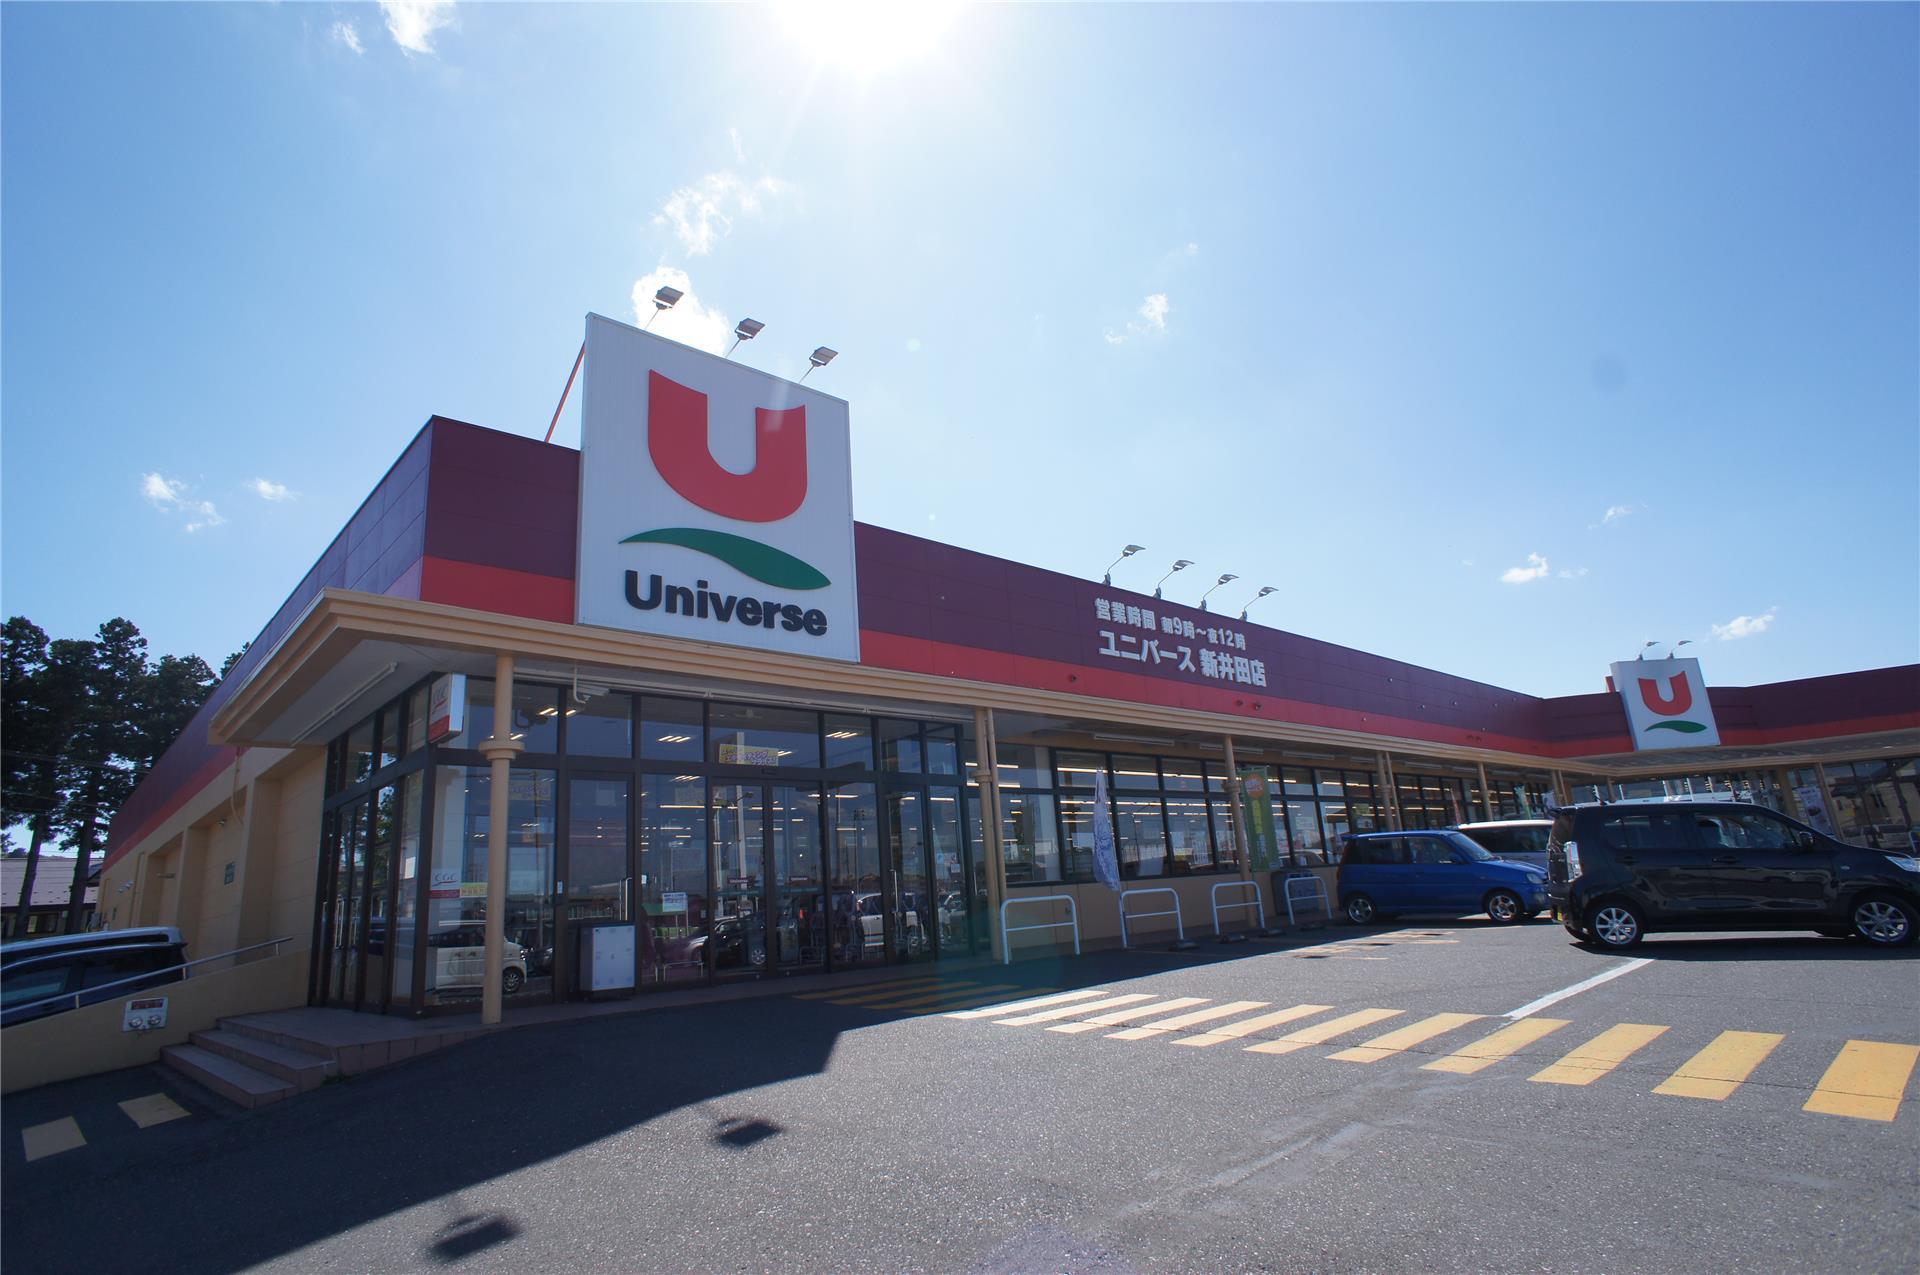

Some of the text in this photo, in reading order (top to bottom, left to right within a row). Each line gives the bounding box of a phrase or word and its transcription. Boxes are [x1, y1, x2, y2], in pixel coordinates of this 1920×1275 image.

[648, 369, 807, 523] U
[624, 569, 828, 637] Universe
[1095, 598, 1156, 631] 営業時間
[1098, 630, 1267, 687] ユニバース 新井田店
[1637, 670, 1693, 717] U
